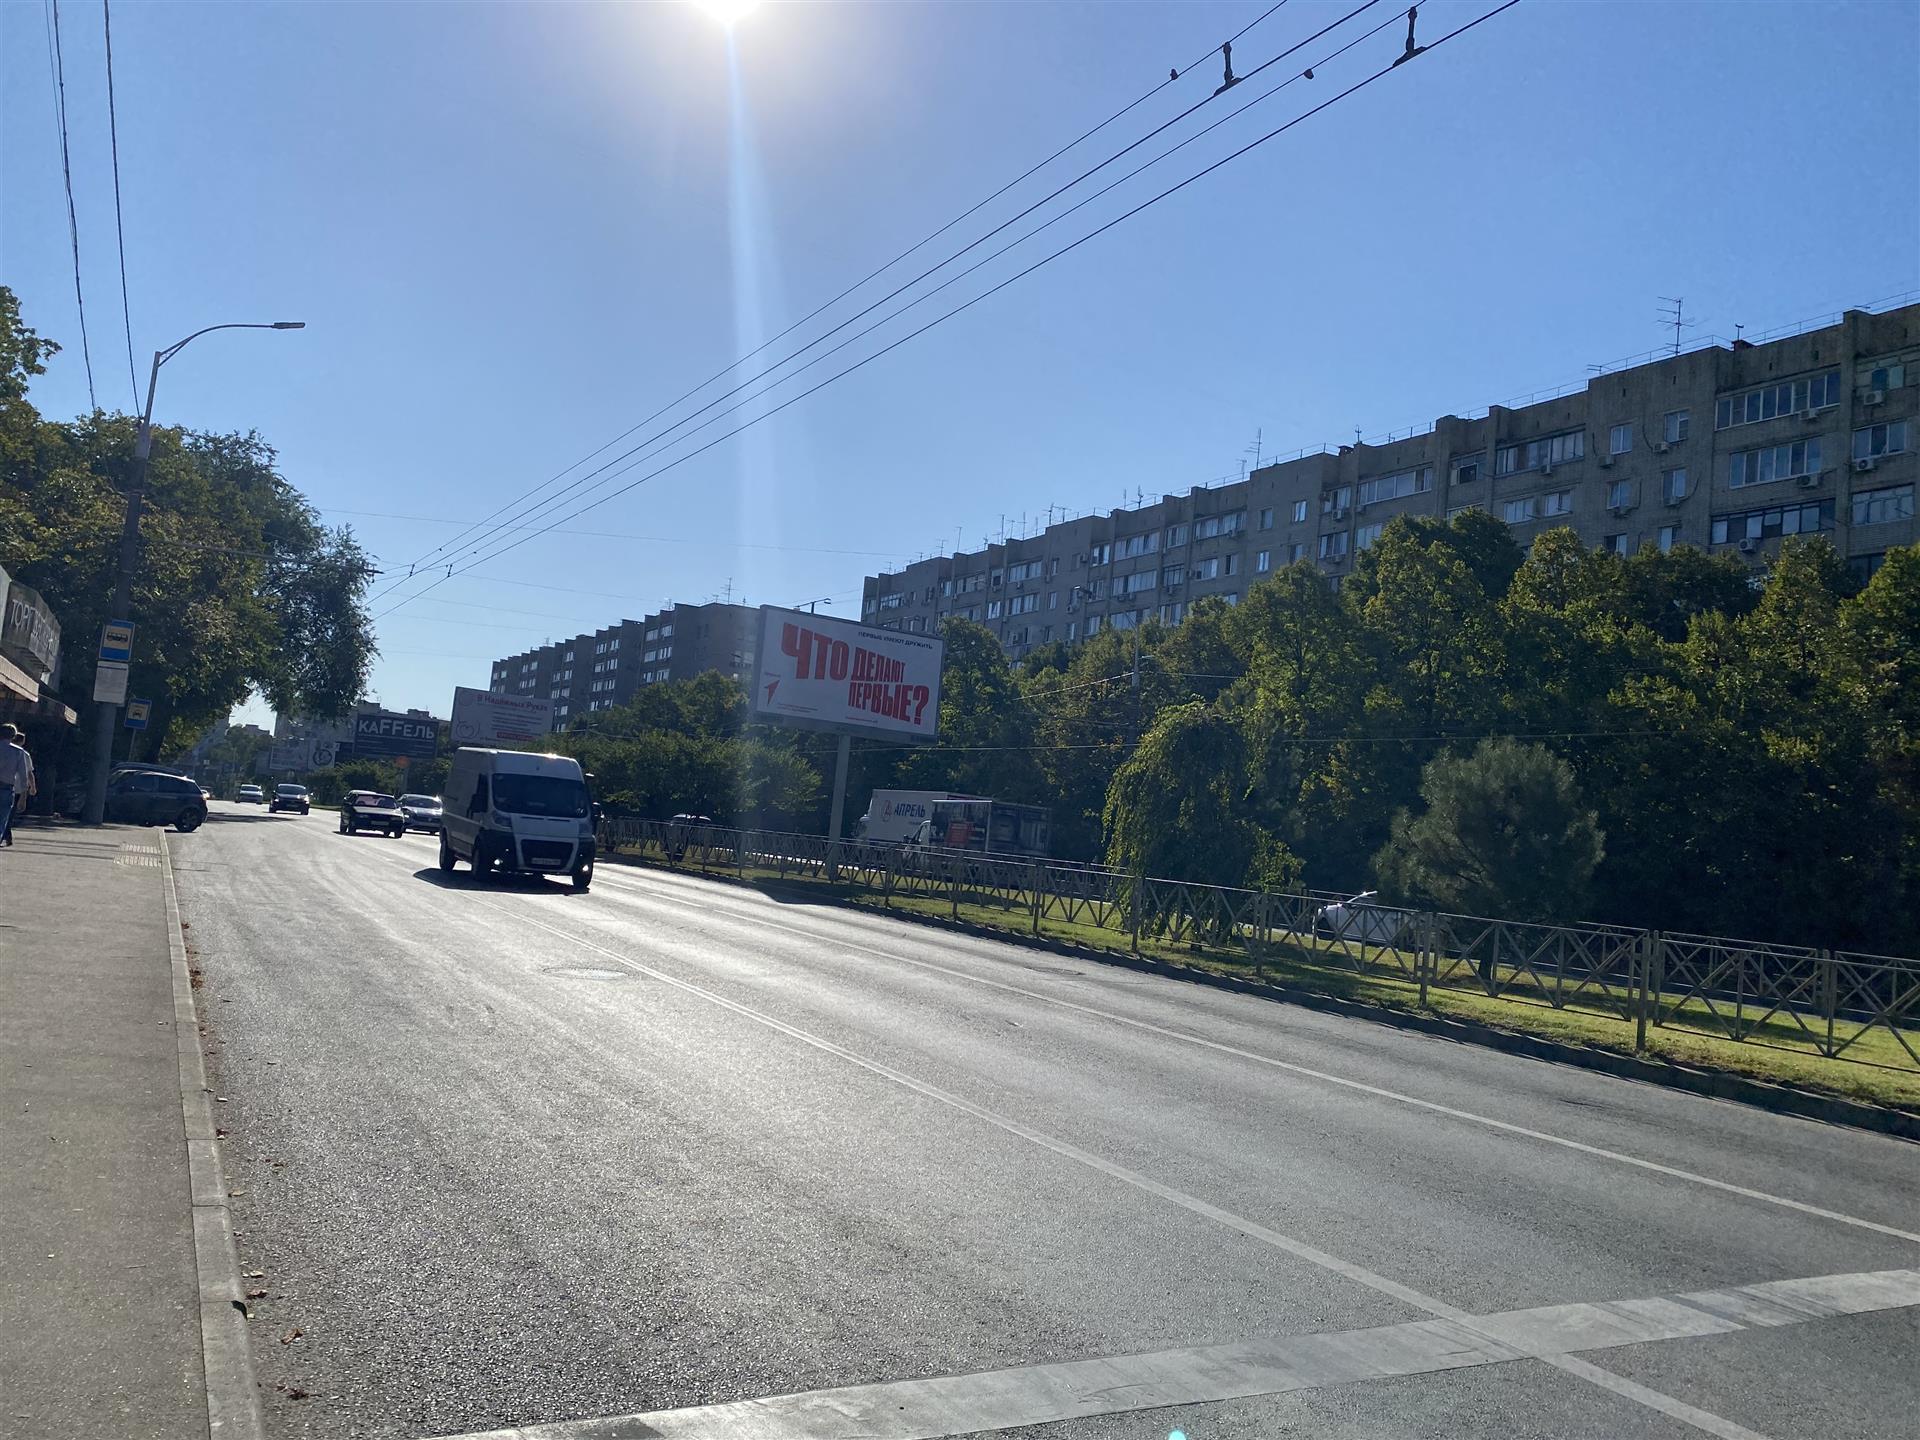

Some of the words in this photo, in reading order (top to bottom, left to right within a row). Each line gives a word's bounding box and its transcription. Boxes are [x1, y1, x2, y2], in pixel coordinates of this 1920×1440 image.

[781, 622, 849, 681] ЧТО
[905, 640, 933, 649] ДРУЖИТЬ
[851, 646, 906, 683] ДЕЛАЮТ
[848, 682, 930, 725] ПЕРВЫЕ?
[894, 803, 926, 817] АПРЕЛЬ
